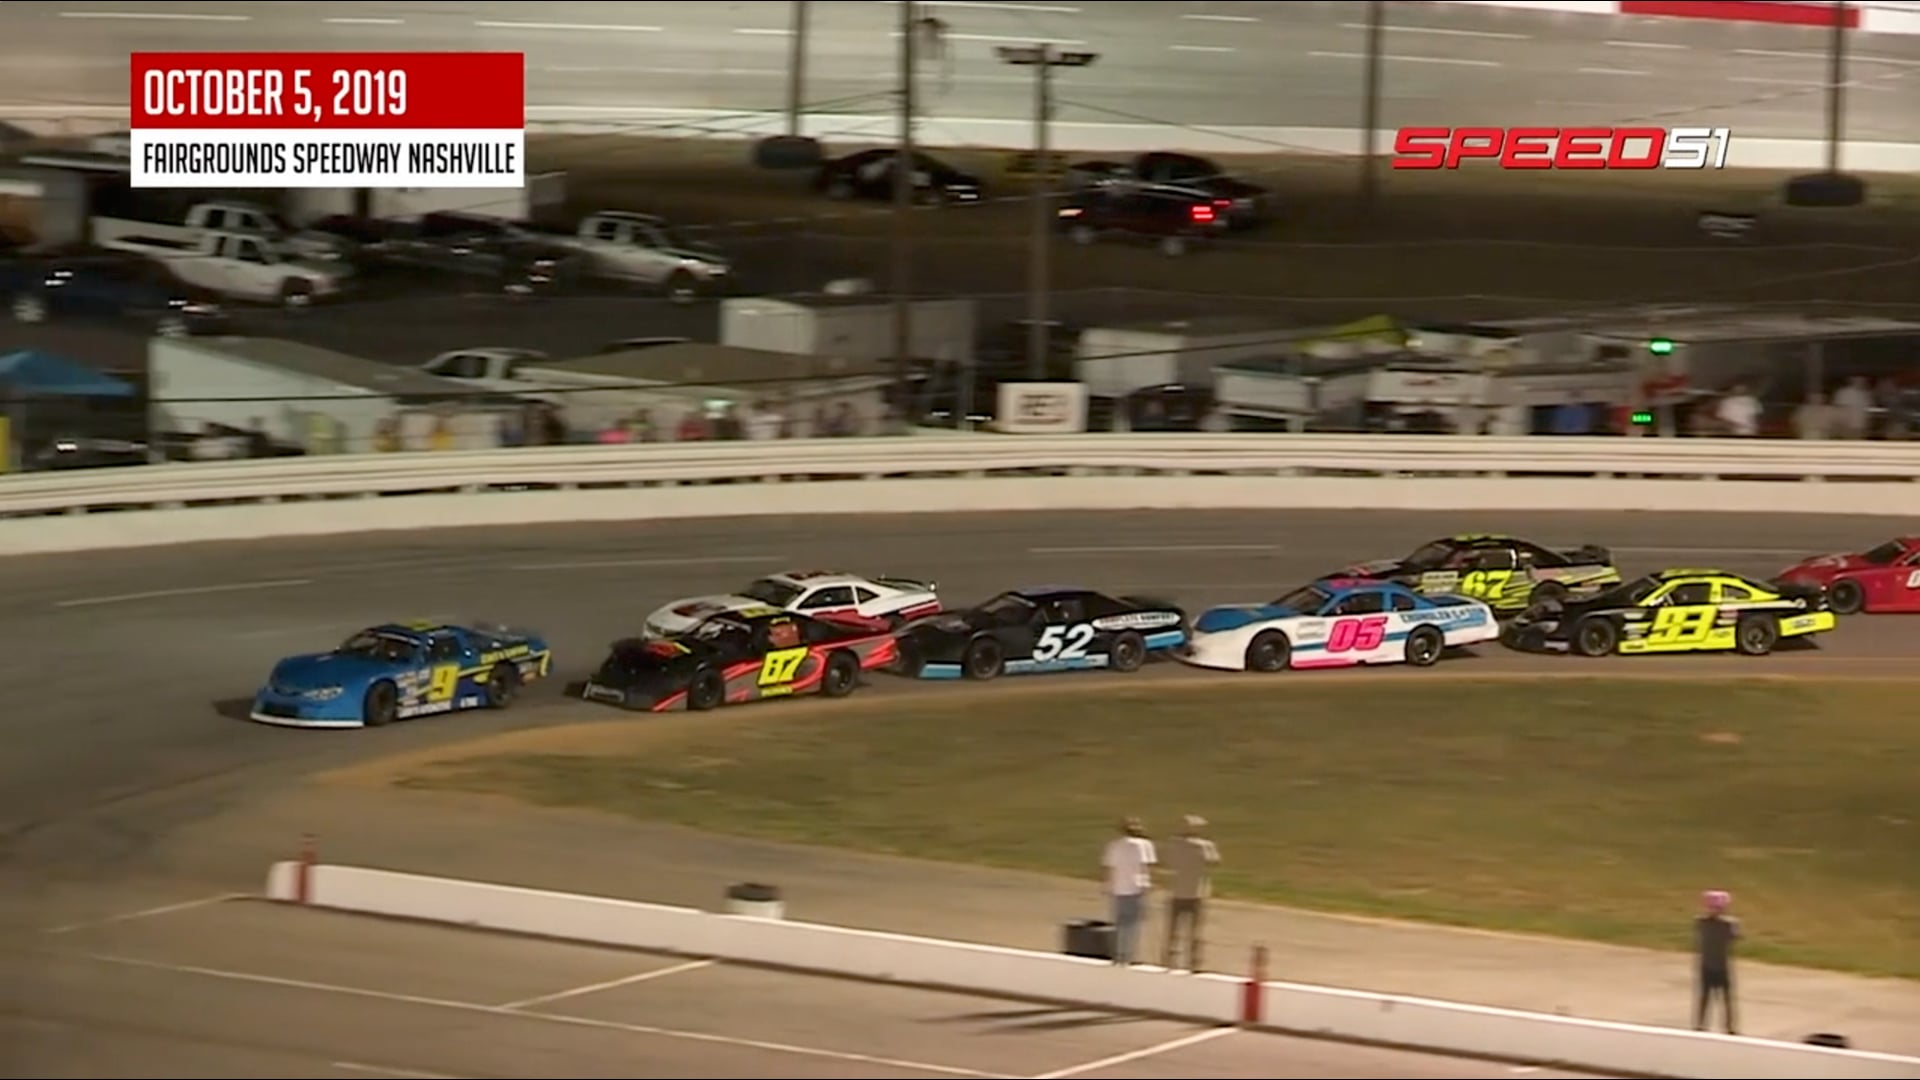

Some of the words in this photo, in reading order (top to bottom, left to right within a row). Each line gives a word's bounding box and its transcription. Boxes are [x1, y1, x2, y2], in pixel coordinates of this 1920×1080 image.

[1462, 569, 1513, 600] 67
[1032, 624, 1096, 662] 52
[1325, 616, 1388, 653] 05
[1647, 606, 1718, 644] 93
[427, 663, 461, 702] 9
[758, 646, 809, 685] 87
